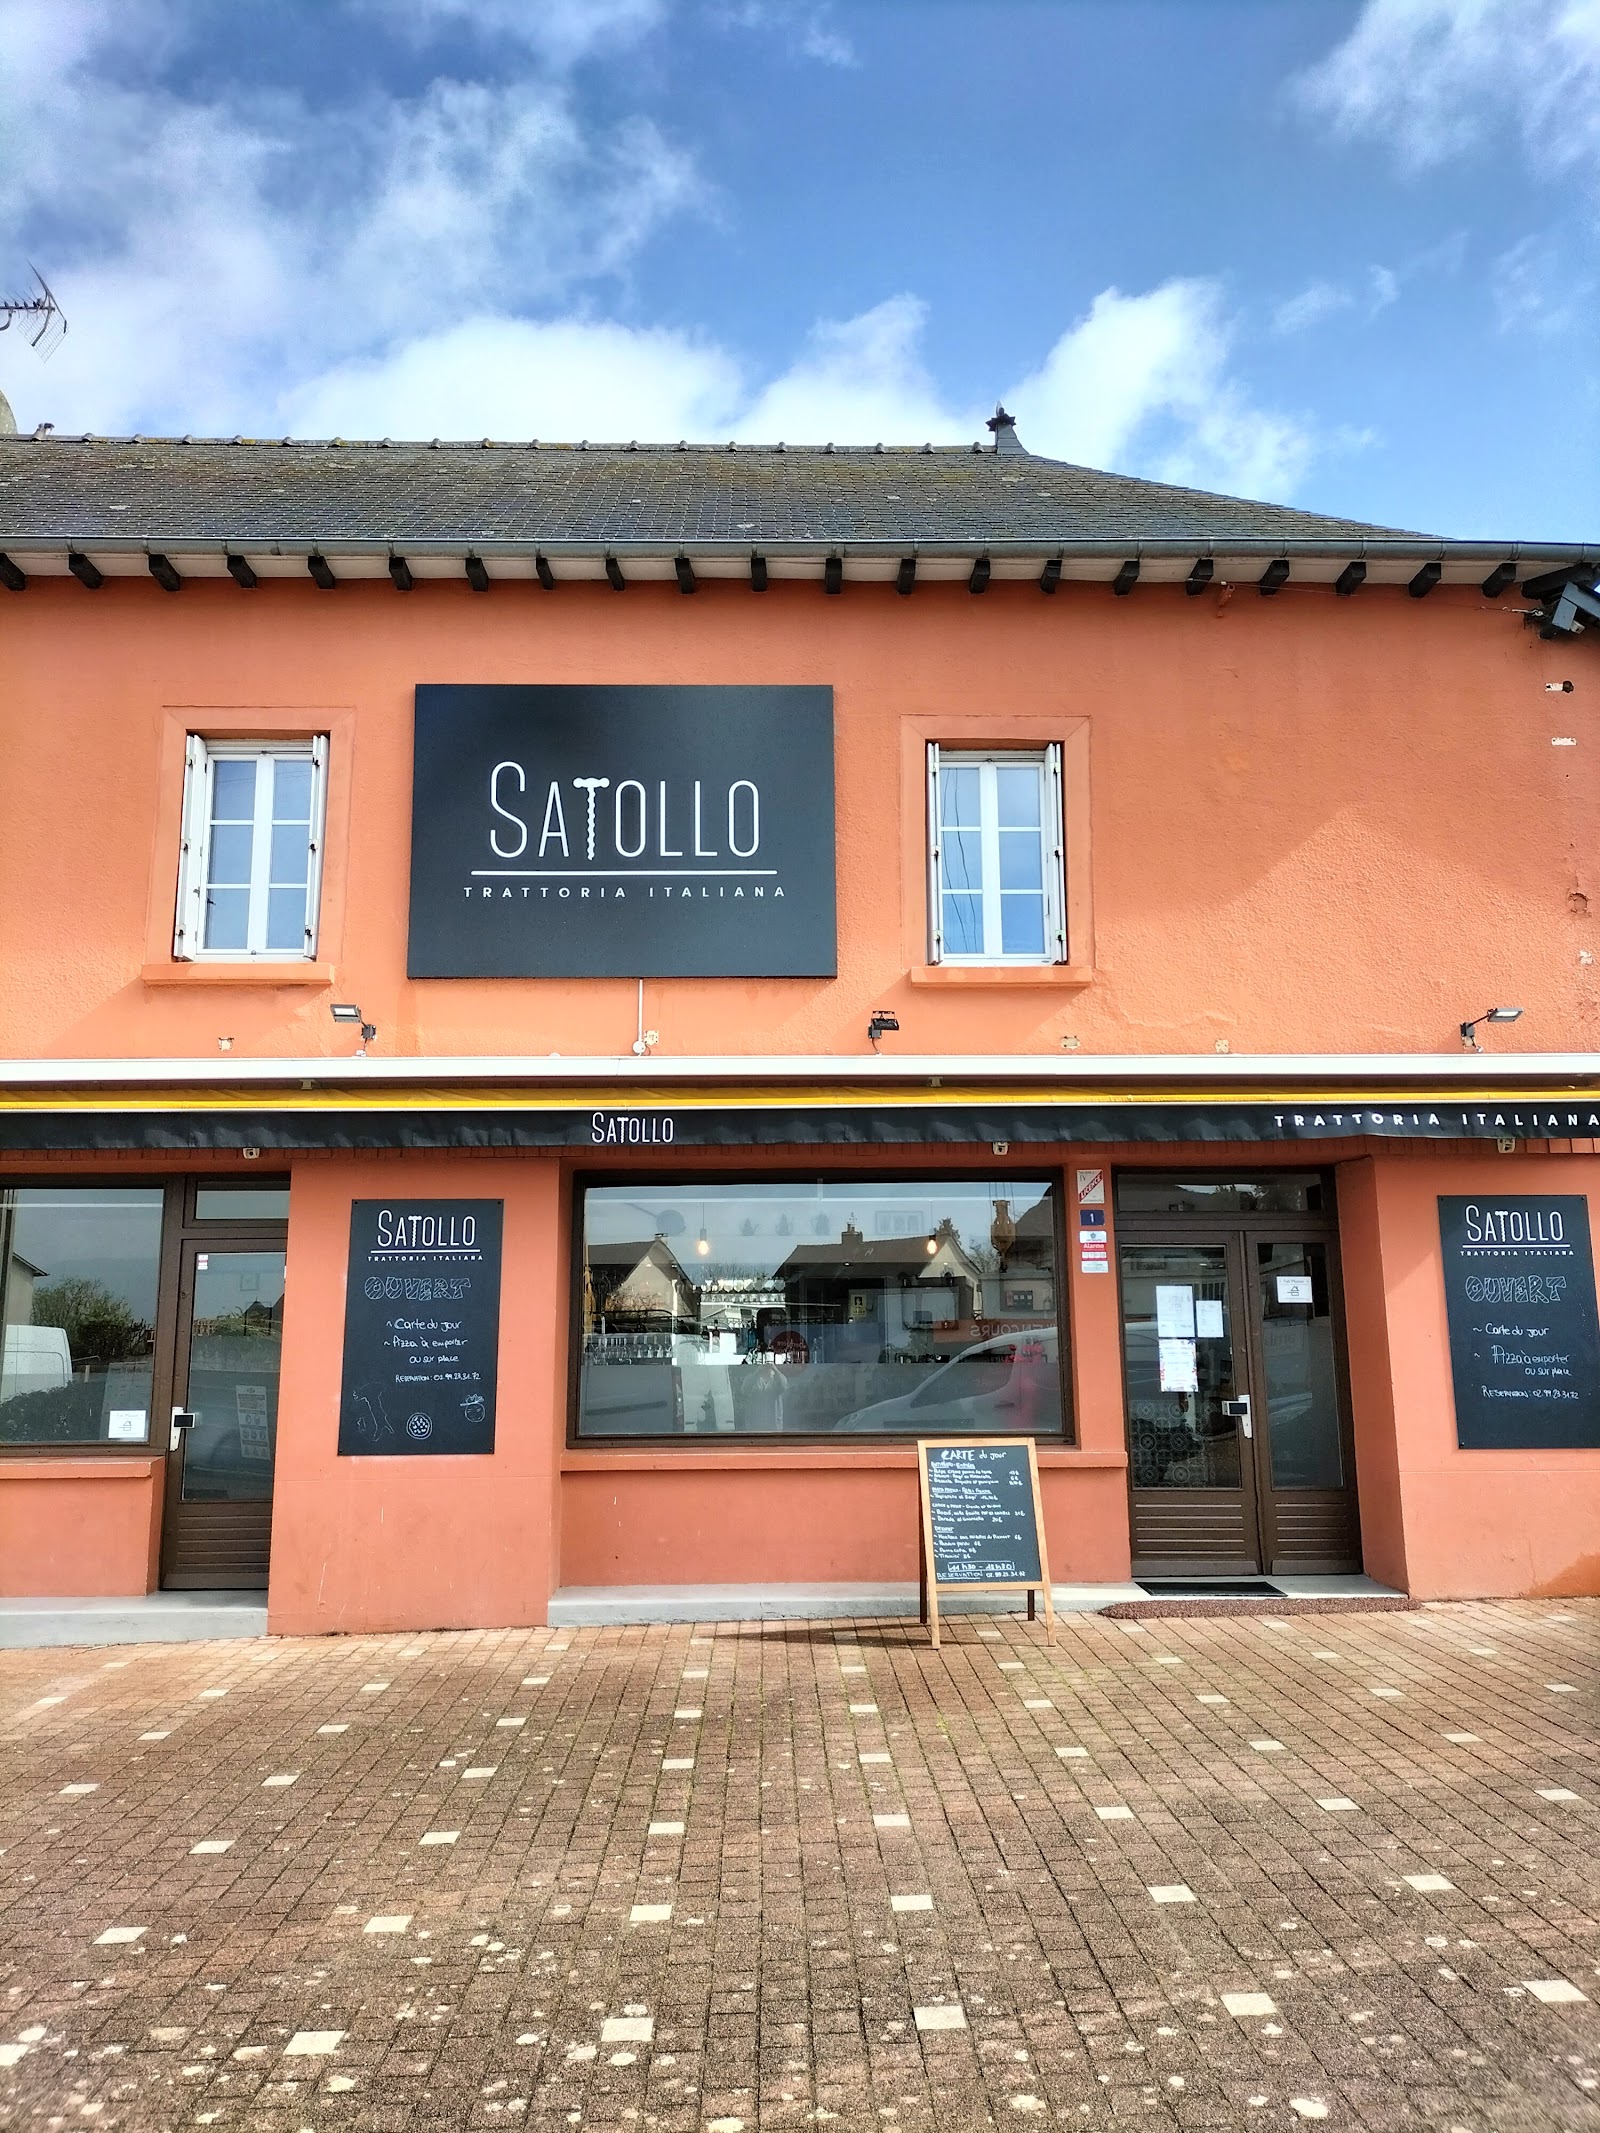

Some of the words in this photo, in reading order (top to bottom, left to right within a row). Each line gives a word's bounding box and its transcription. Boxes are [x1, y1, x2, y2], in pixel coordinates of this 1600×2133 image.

[489, 760, 761, 861] SATOLLO
[463, 886, 626, 899] TRATTORIA
[649, 886, 785, 898] ITALIANA
[1274, 1112, 1440, 1128] TRATTORIA
[1462, 1112, 1600, 1126] ITALIANA
[591, 1111, 674, 1145] SATOLLO
[1080, 1175, 1101, 1199] LICENCE
[1089, 1213, 1095, 1223] 1
[1465, 1204, 1565, 1243] SATOLLO
[377, 1209, 476, 1248] SATOLLO
[364, 1275, 471, 1301] OUVERT
[1465, 1274, 1567, 1304] OUVERT
[394, 1318, 426, 1331] Carte
[426, 1318, 438, 1330] du
[1485, 1322, 1511, 1335] Carte
[1511, 1325, 1523, 1335] du
[393, 1335, 418, 1348] Pizza
[432, 1338, 468, 1349] emporter
[409, 1355, 421, 1364] ou
[422, 1355, 434, 1363] sur
[437, 1354, 459, 1363] place
[1532, 1353, 1571, 1366] emporter
[1524, 1368, 1536, 1376] ou
[1537, 1368, 1549, 1376] sur
[1551, 1367, 1573, 1378] place
[941, 1449, 975, 1461] CARTE
[978, 1450, 988, 1459] du
[990, 1452, 1007, 1461] jour
